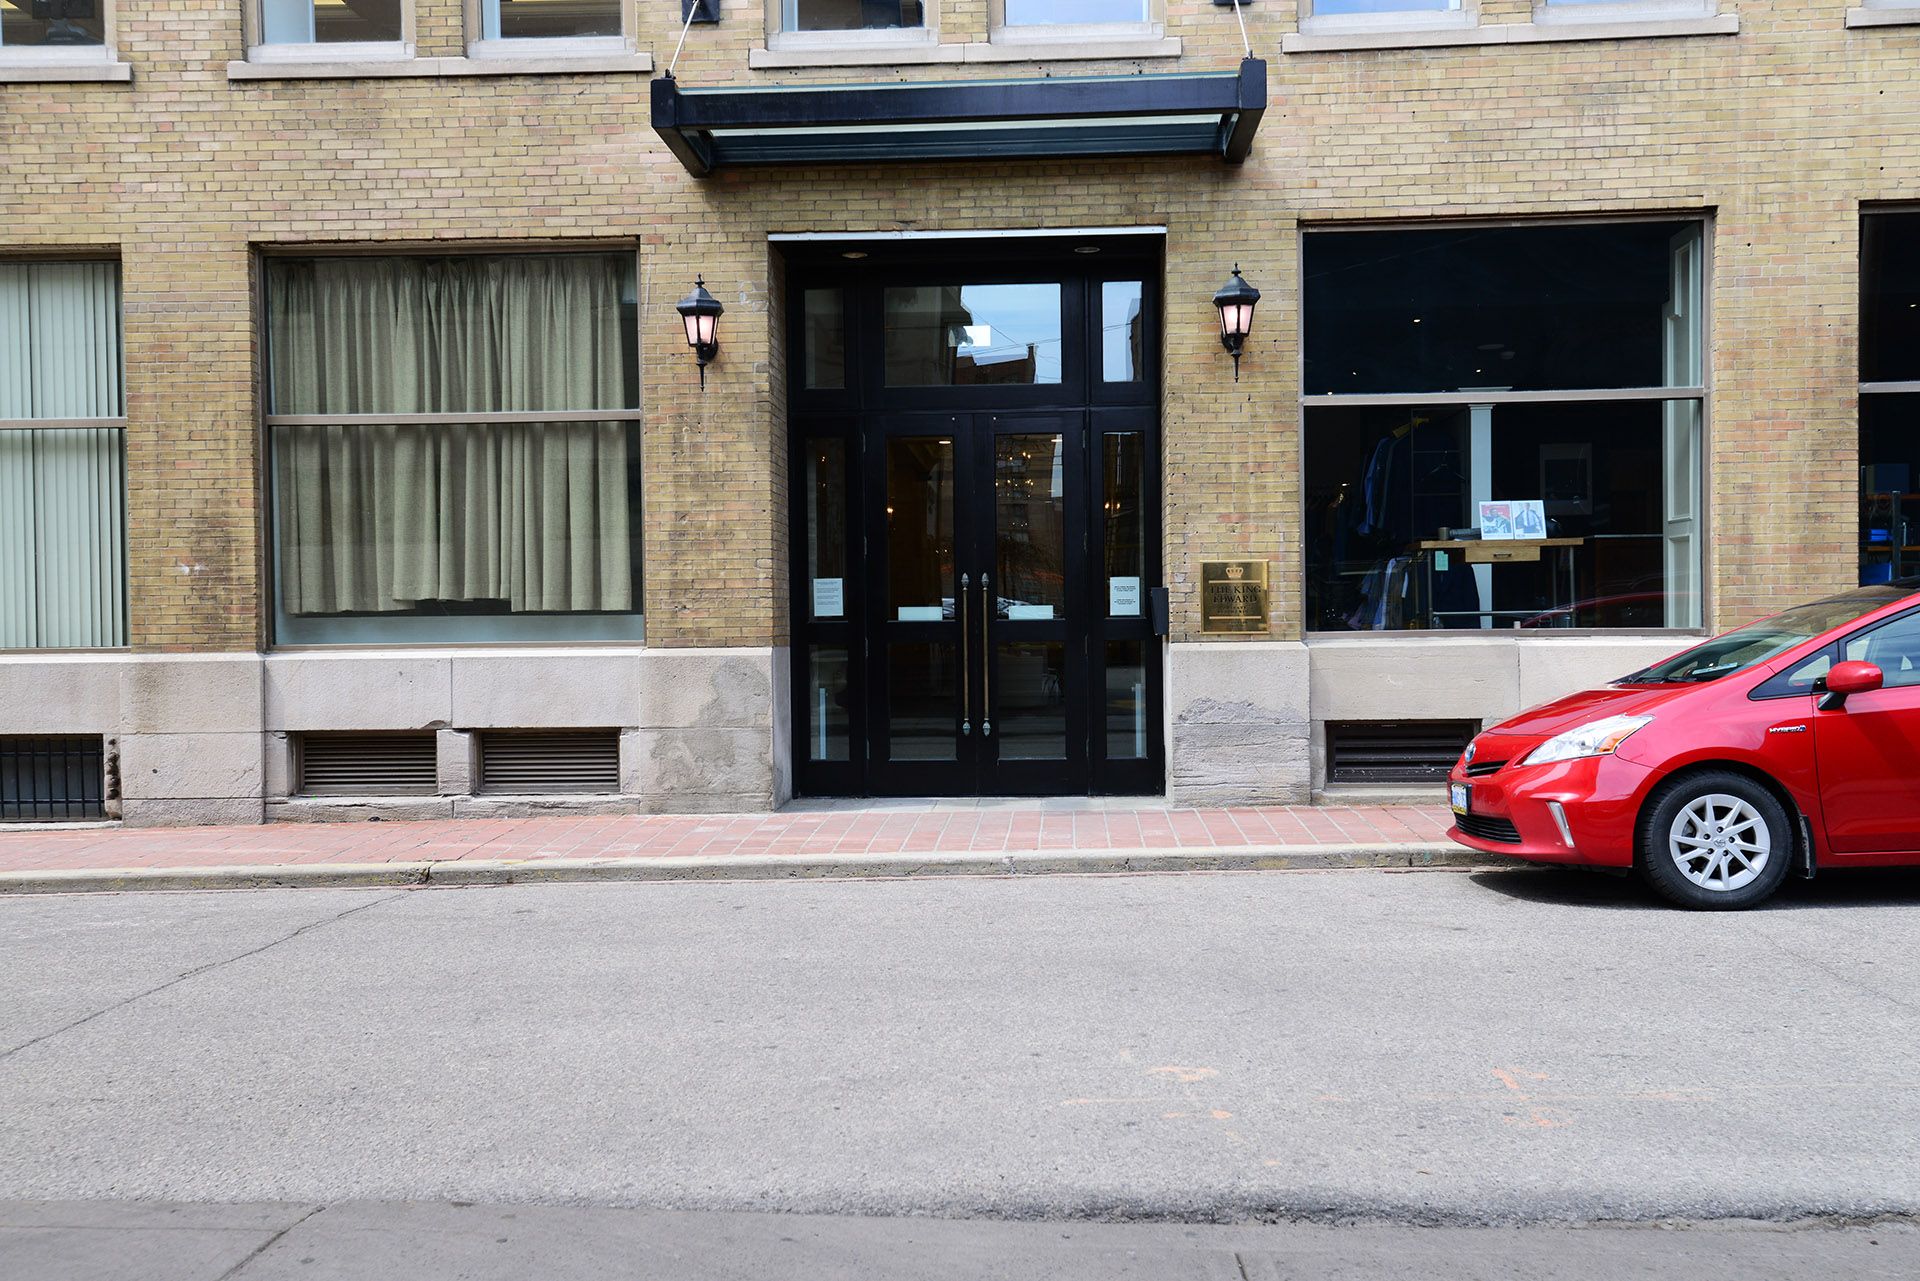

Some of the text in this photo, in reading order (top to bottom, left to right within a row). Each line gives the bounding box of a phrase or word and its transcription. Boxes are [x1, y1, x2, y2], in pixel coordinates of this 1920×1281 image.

[1210, 585, 1261, 594] THE KING
[1213, 594, 1257, 603] EDWARD
